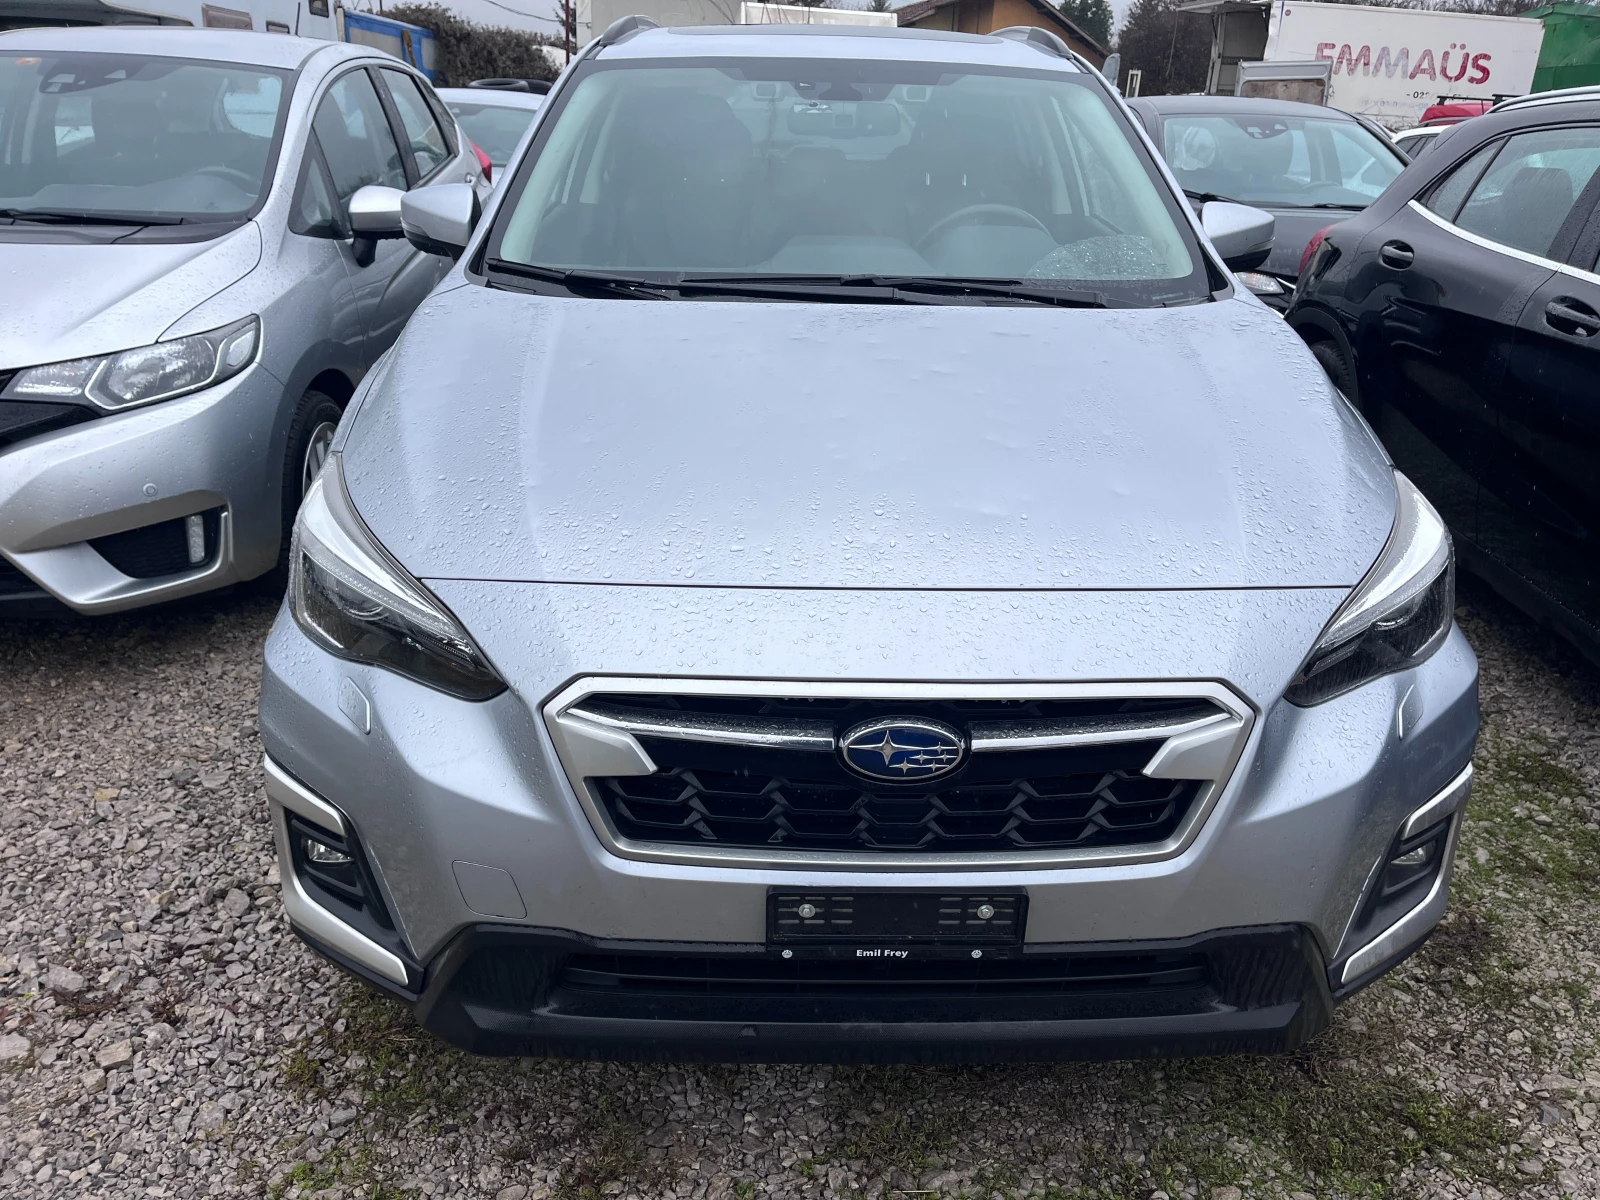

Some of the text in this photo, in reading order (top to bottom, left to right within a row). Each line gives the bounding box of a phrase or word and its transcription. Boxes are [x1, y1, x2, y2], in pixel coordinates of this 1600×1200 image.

[1315, 42, 1492, 84] EMMAÜS
[856, 949, 908, 959] Emil Frey
